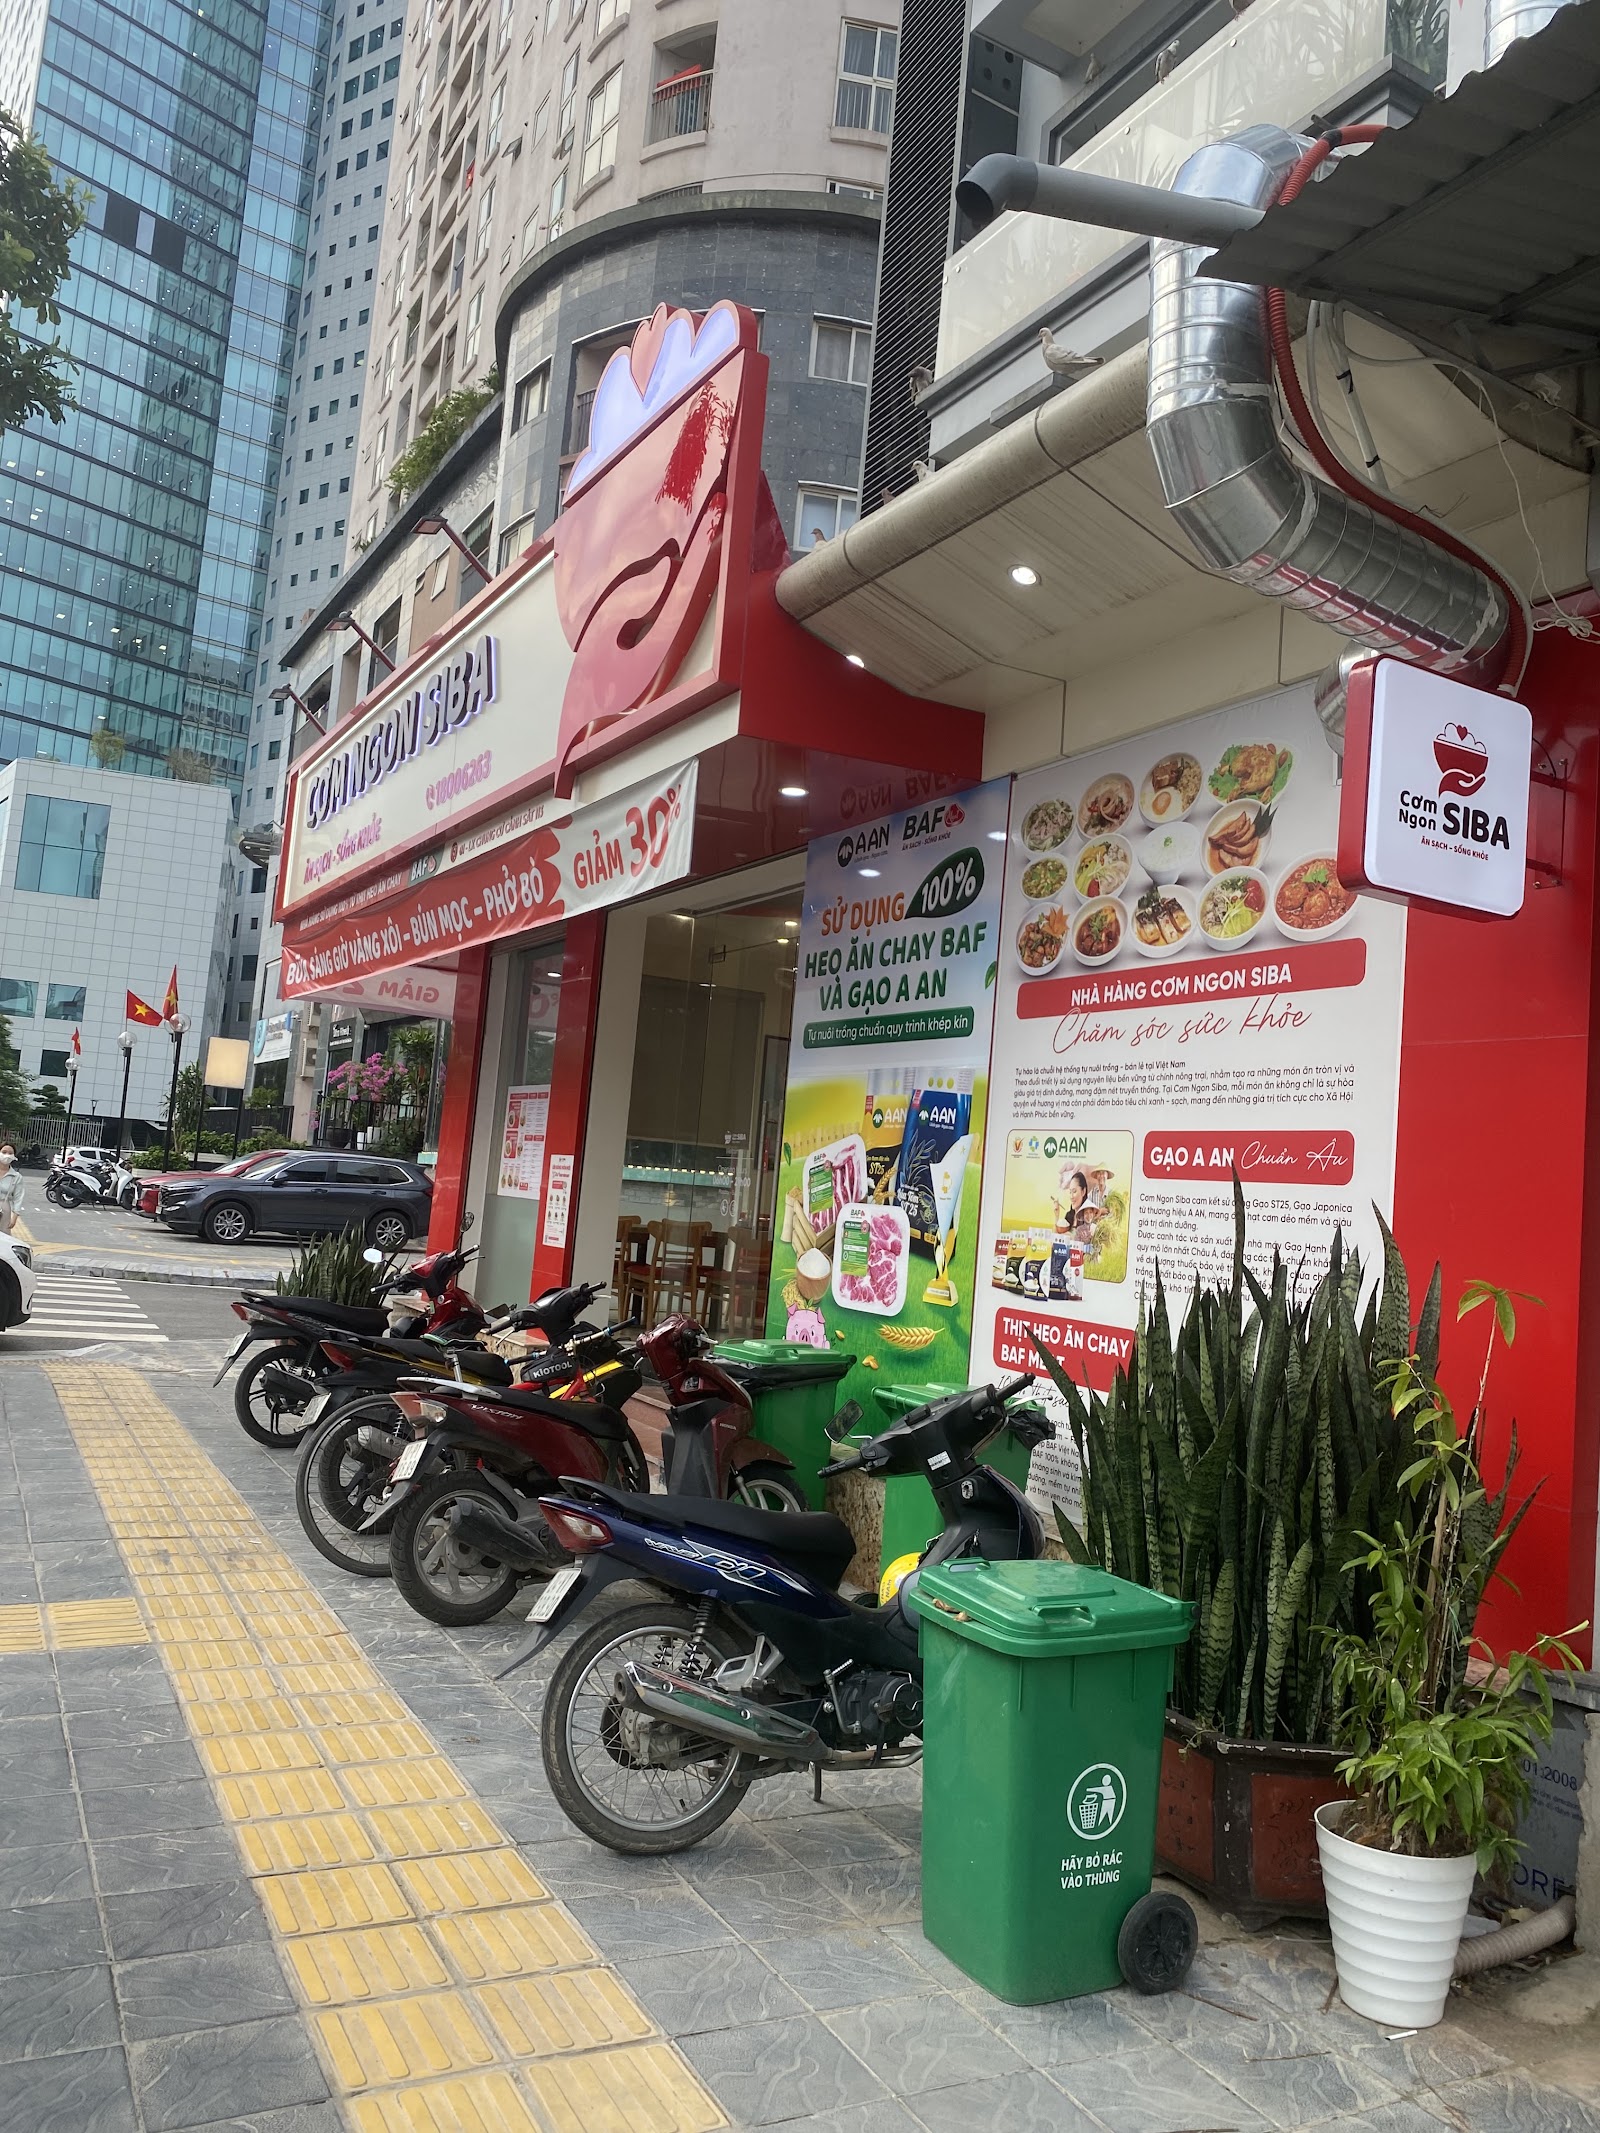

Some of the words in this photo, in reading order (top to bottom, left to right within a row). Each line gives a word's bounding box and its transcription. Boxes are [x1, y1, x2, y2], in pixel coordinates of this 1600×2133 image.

[351, 691, 421, 798] NGON
[423, 635, 496, 746] SIBA
[435, 750, 492, 806] 18006263
[1400, 790, 1437, 814] Cơm
[573, 829, 625, 889] GIẢM
[625, 784, 682, 877] 30%
[902, 806, 945, 840] BAF
[1398, 808, 1436, 831] Ngon
[1443, 802, 1510, 850] SIBA
[1421, 834, 1430, 846] ĂN
[1431, 838, 1449, 851] SẠCH
[1454, 843, 1471, 858] SỐNG
[1473, 848, 1489, 861] KHỎE
[410, 857, 429, 882] BAF
[349, 929, 381, 965] VÀNG
[381, 916, 402, 956] XÔI
[410, 904, 438, 946] BÚN
[438, 896, 473, 942] MỌC
[482, 864, 518, 921] PHỞ
[519, 856, 544, 908] BÒ
[821, 896, 848, 936] SỬ
[850, 891, 904, 936] DỤNG
[921, 857, 976, 914] 100%
[805, 948, 842, 978] HEO
[846, 936, 874, 972] ĂN
[879, 931, 935, 968] CHAY
[940, 921, 987, 958] BAF
[820, 975, 842, 1011] VÀ
[848, 976, 890, 1015] GẠO
[896, 976, 909, 1002] A
[915, 968, 947, 1000] AN
[1071, 983, 1099, 1007] NHÀ
[1104, 979, 1147, 1004] HÀNG
[1150, 975, 1189, 1000] CƠM
[1194, 970, 1246, 994] NGON
[1250, 963, 1291, 985] SIBA
[808, 1029, 816, 1043] Tự
[817, 1027, 834, 1040] nuôi
[835, 1021, 856, 1041] trồng
[859, 1021, 884, 1037] chuẩn
[887, 1023, 903, 1037] quy
[905, 1019, 926, 1033] trình
[928, 1016, 951, 1033] khép
[954, 1014, 967, 1029] kín
[1053, 1007, 1126, 1054] Chăm
[1130, 1015, 1174, 1047] sóc
[1178, 1012, 1232, 1043] sức
[1239, 992, 1312, 1034] khỏe
[1192, 1084, 1209, 1094] Ngon
[1309, 1093, 1324, 1101] cho
[930, 1106, 956, 1124] AAN
[1059, 1136, 1087, 1152] AAN
[1150, 1147, 1189, 1171] GẠO
[1192, 1147, 1205, 1166] A
[1209, 1148, 1234, 1167] AN
[1241, 1141, 1298, 1169] Chuẩn
[1306, 1138, 1348, 1171] Âu
[1157, 1195, 1173, 1204] Ngon
[1176, 1196, 1190, 1204] Siba
[1253, 1199, 1269, 1210] Gạo
[1271, 1200, 1291, 1211] ST25,
[1294, 1201, 1310, 1212] Gạo
[1313, 1202, 1352, 1213] Japonica
[1209, 1212, 1232, 1221] mang
[1285, 1242, 1302, 1253] Gạo
[1003, 1317, 1030, 1342] THỊT
[1033, 1323, 1060, 1344] HEO
[1063, 1324, 1084, 1349] ĂN
[1088, 1333, 1130, 1358] CHAY
[1001, 1344, 1025, 1364] BAF
[1061, 1855, 1083, 1871] HÃY
[1086, 1851, 1100, 1869] BỎ
[1102, 1849, 1122, 1865] RÁC
[1061, 1872, 1082, 1889] VÀO
[1085, 1868, 1120, 1887] THÙNG
